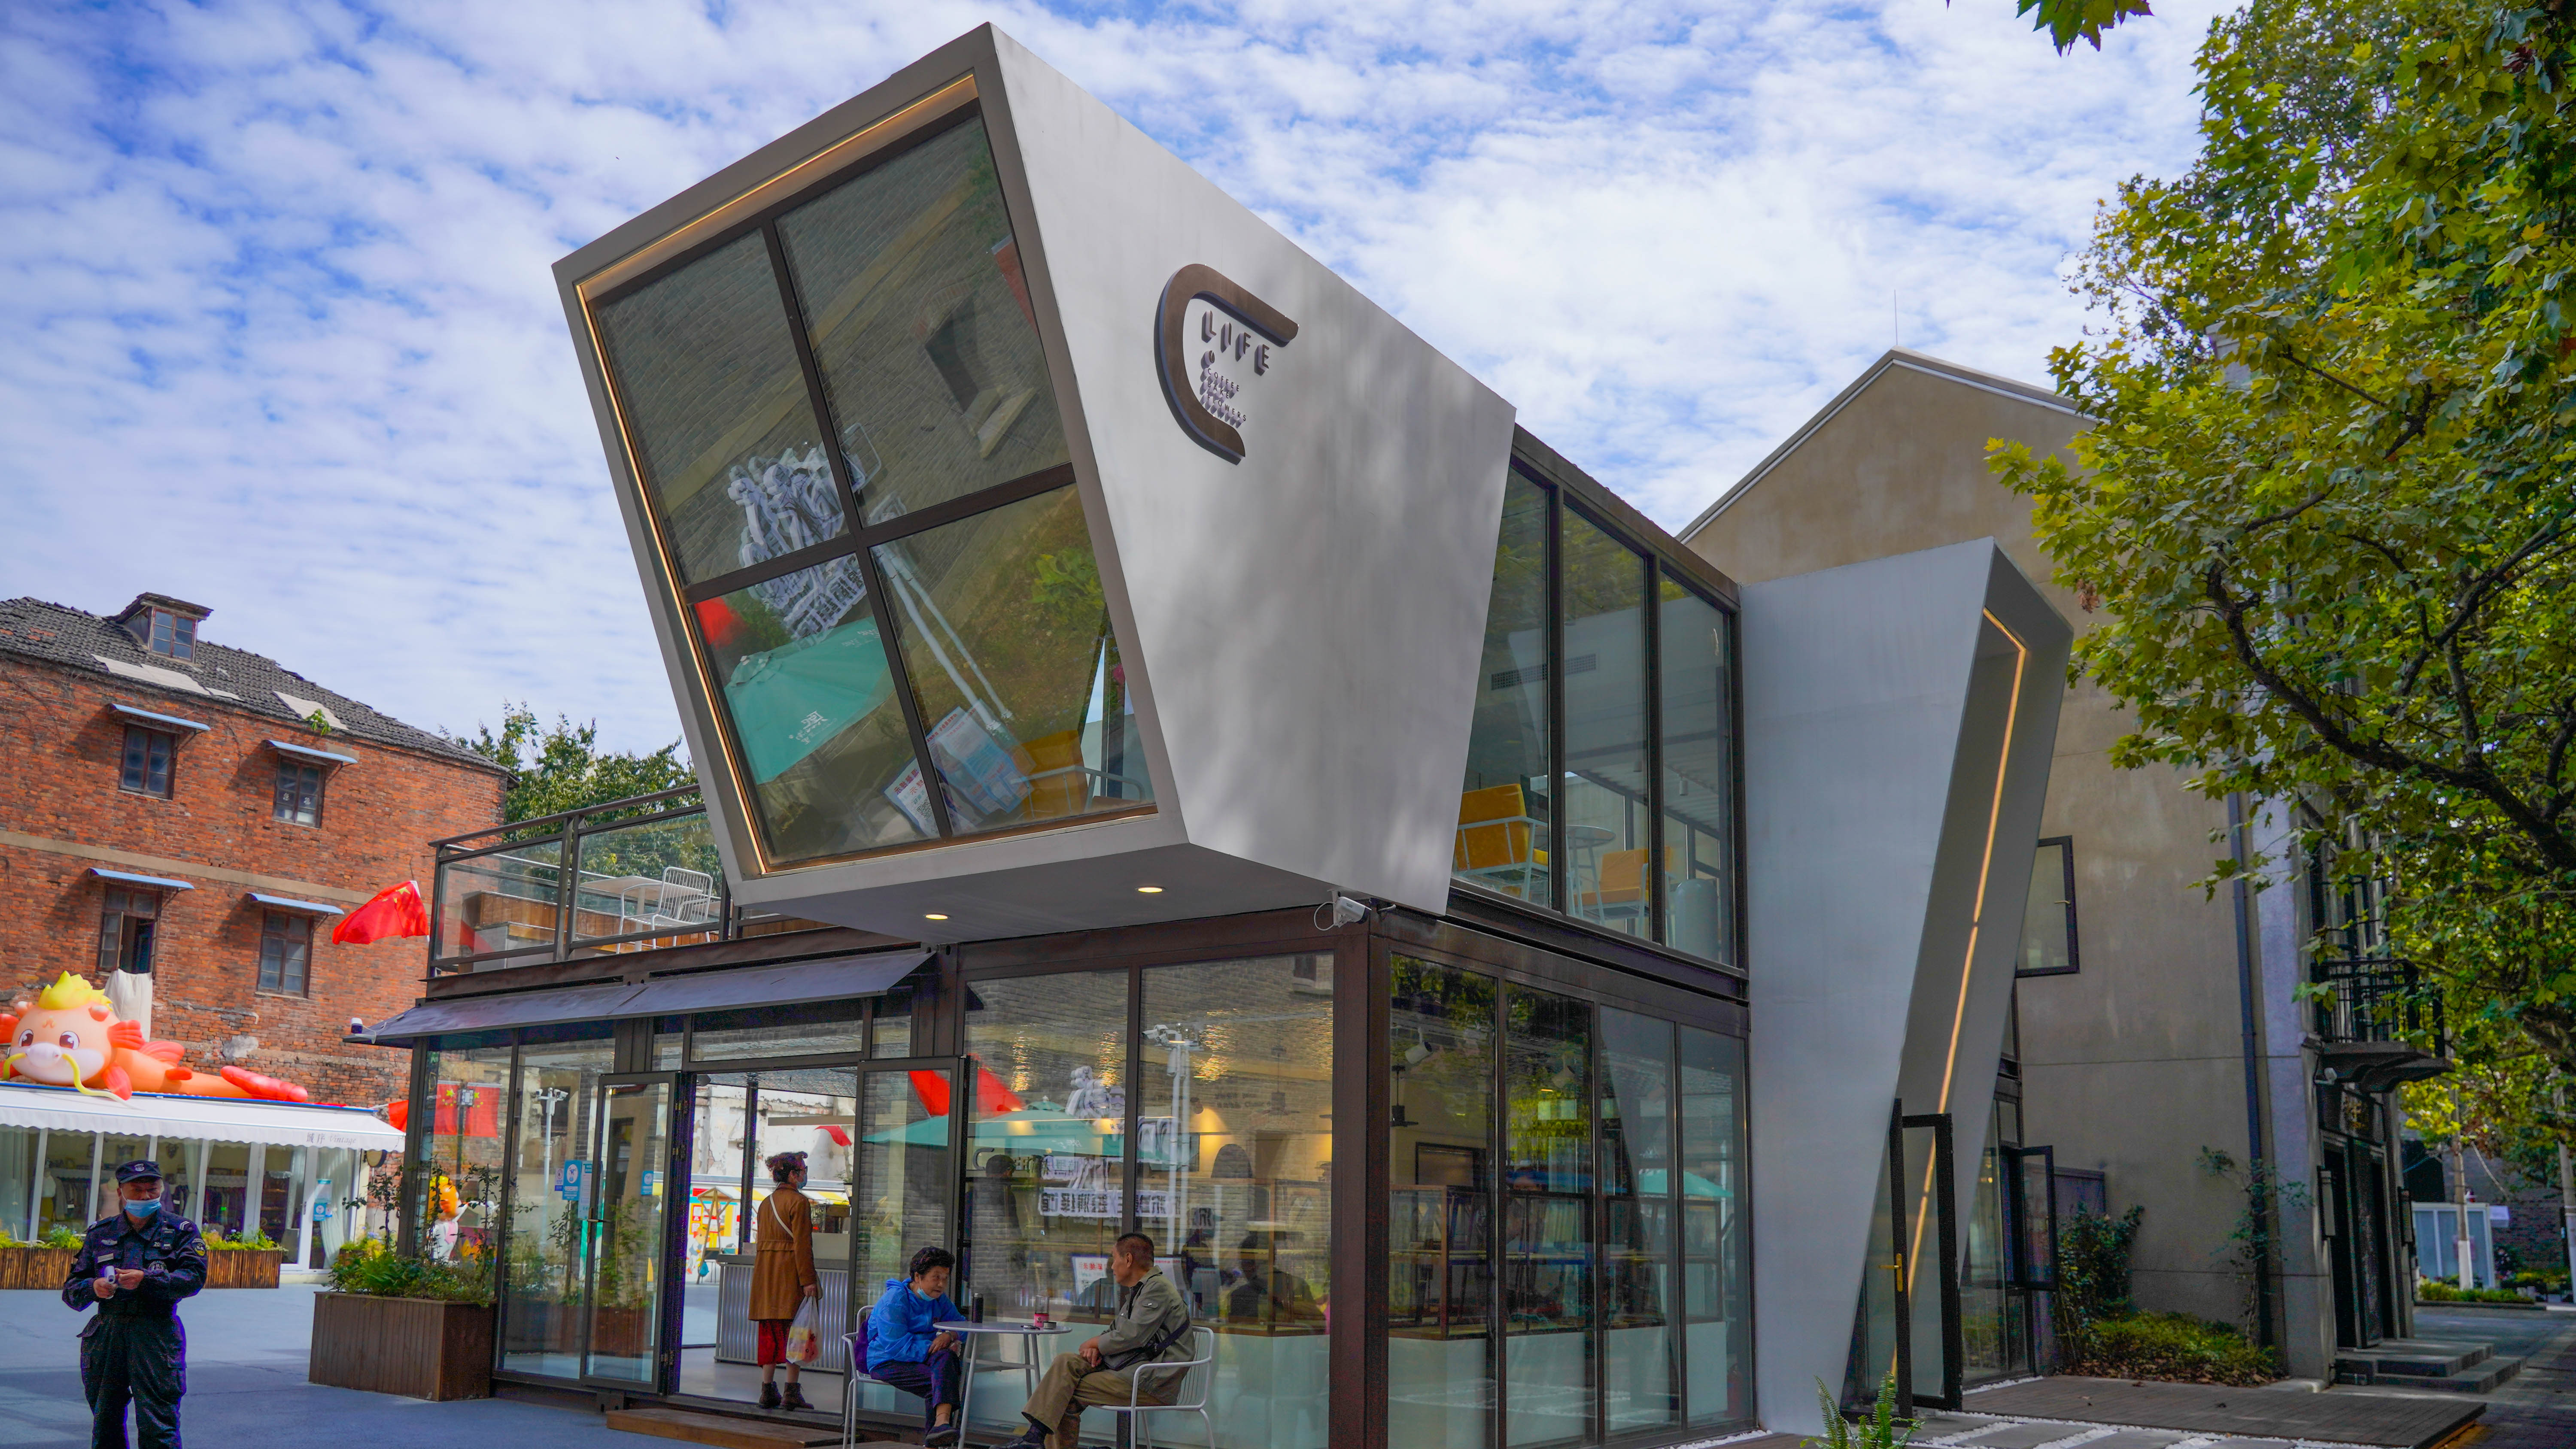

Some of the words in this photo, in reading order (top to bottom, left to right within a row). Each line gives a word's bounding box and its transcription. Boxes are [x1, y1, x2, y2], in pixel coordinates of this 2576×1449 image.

[1203, 310, 1270, 372] LIFE
[1208, 368, 1239, 392] COFFEE
[1208, 381, 1230, 399] BAKE
[1207, 394, 1247, 421] FLOWERS
